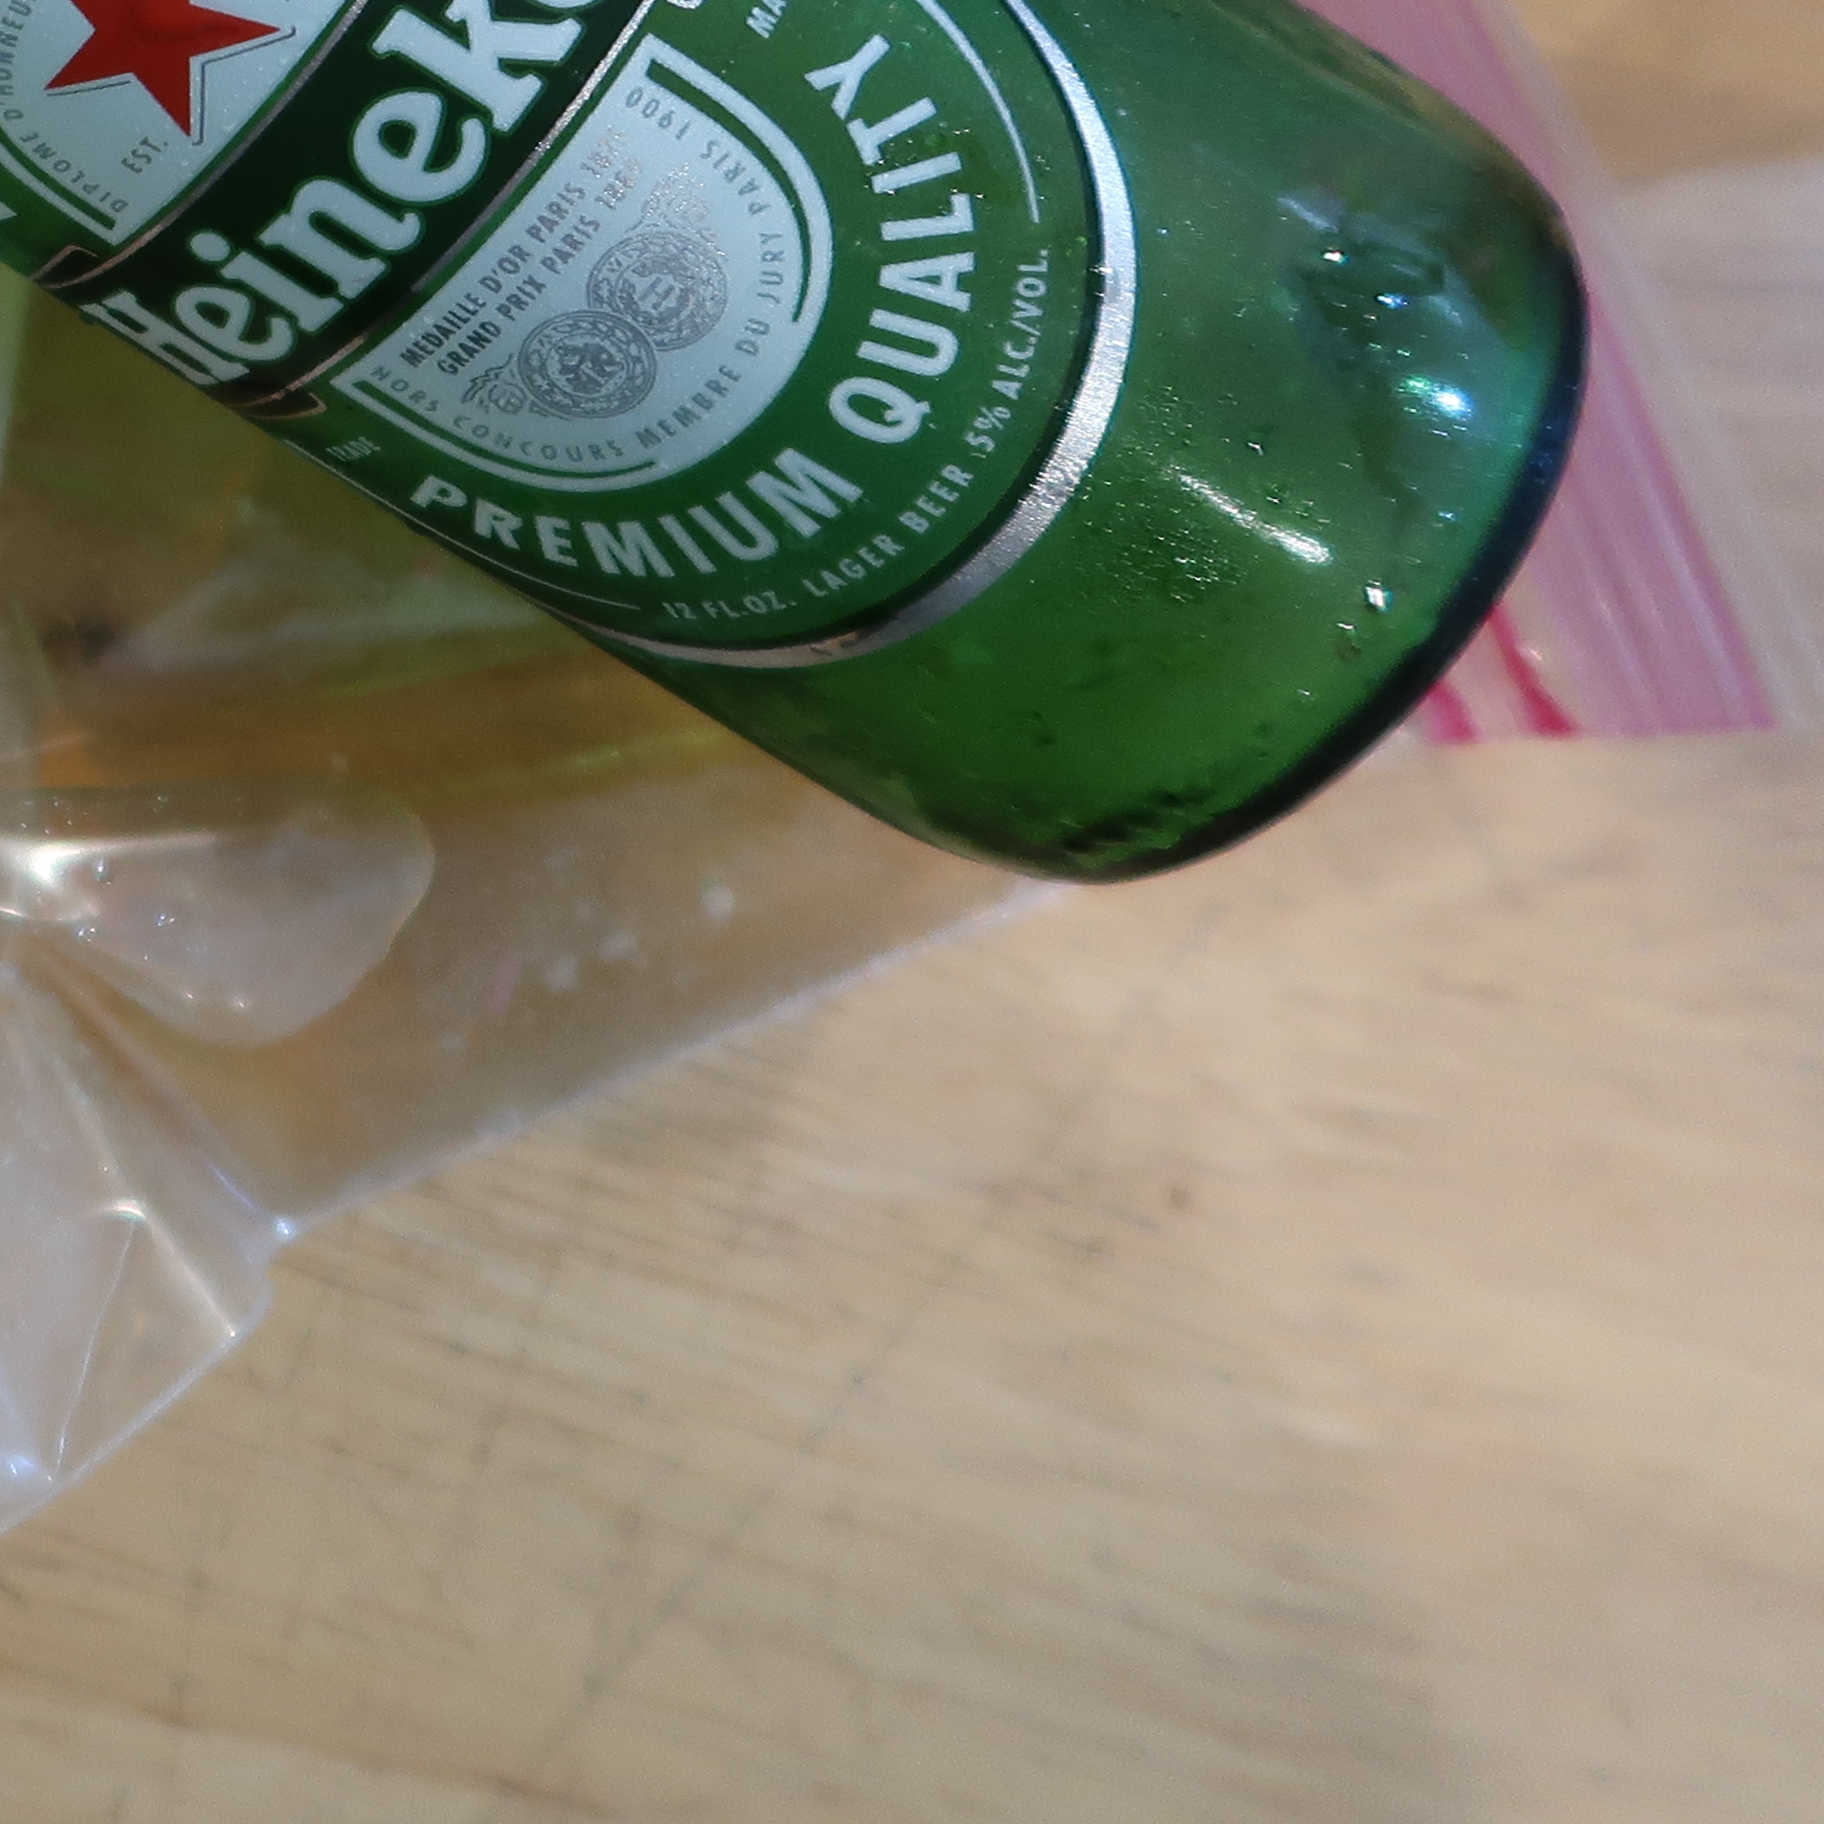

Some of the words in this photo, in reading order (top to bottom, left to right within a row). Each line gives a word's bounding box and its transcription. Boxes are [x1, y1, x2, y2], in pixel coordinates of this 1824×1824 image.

[623, 85, 693, 141] 1900
[19, 130, 129, 214] DIPLOME
[120, 135, 168, 176] EST.
[699, 138, 772, 217] PARIS
[399, 292, 486, 368] MEDAILLE
[478, 244, 532, 294] D'OR
[525, 181, 586, 243] PARIS
[410, 446, 865, 578] PREMIUM
[804, 33, 976, 446] QUALITY
[436, 320, 502, 375] GRAND
[495, 274, 548, 321] PRIX
[540, 214, 601, 275] PARIS
[756, 232, 787, 306] JURY
[734, 317, 771, 357] DU
[370, 363, 440, 414] HORS
[635, 364, 743, 449] MEMBRE
[453, 414, 624, 463] CONCOURS
[661, 600, 697, 620] 12
[801, 533, 906, 598] LAGER
[897, 463, 976, 535] BEER
[963, 406, 1013, 454] 5%
